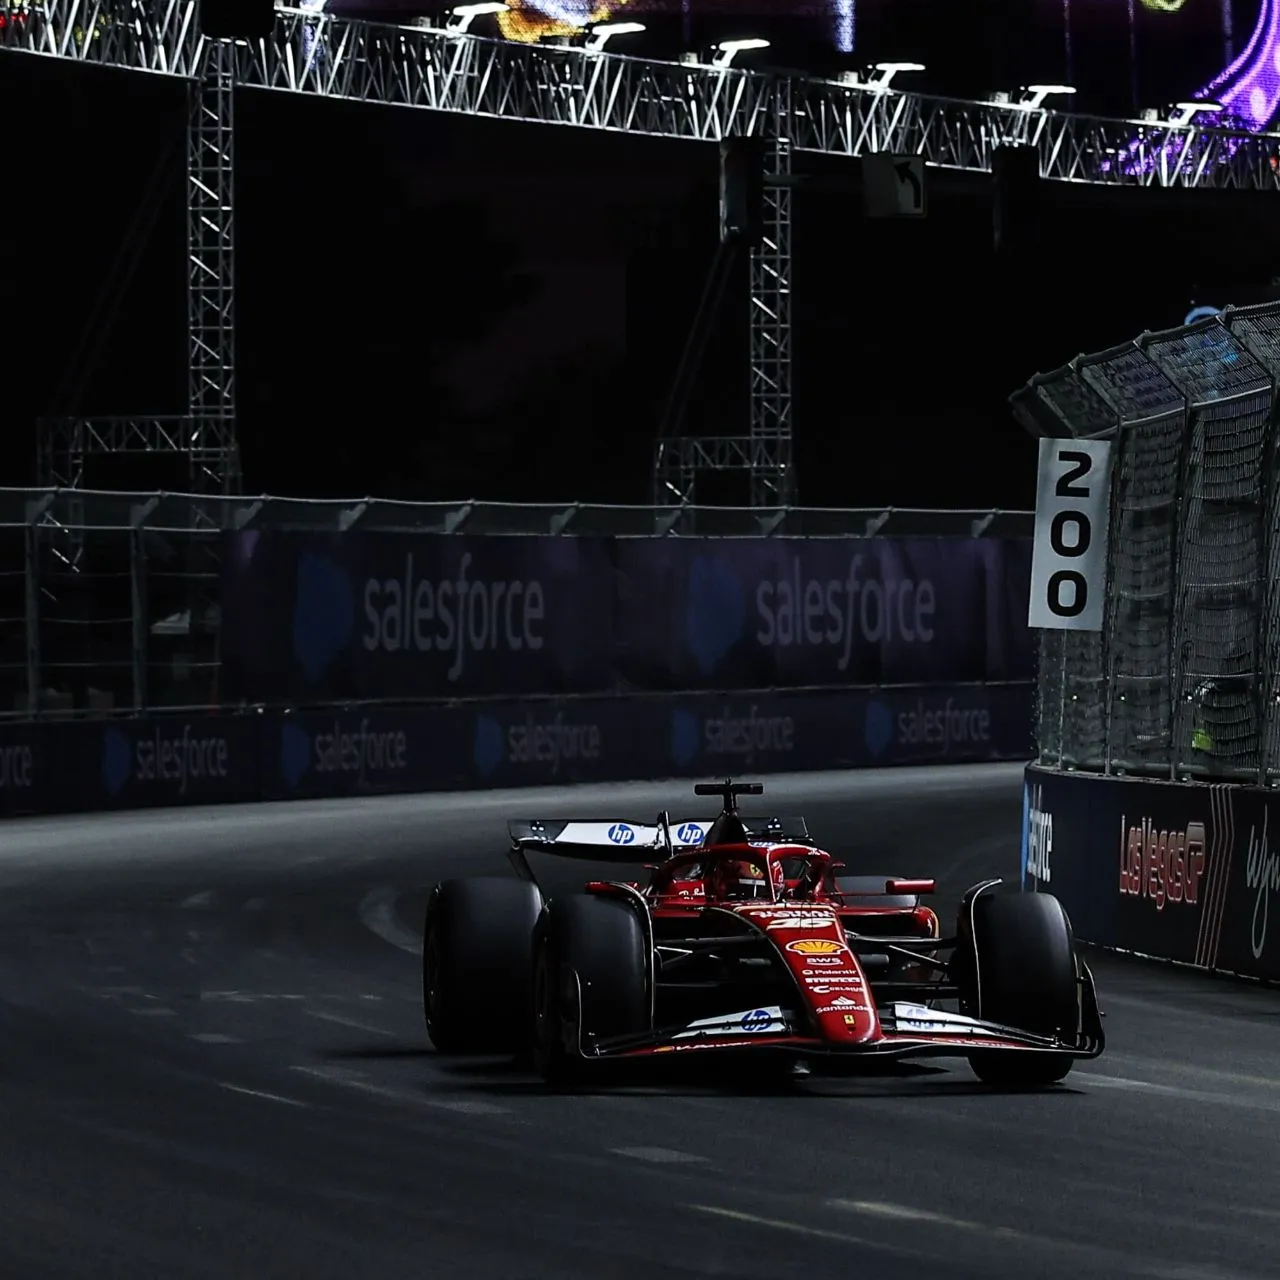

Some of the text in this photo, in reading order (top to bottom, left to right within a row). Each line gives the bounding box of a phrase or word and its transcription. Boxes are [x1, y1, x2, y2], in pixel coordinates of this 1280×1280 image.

[1047, 451, 1092, 616] 200
[363, 552, 545, 682] salesforce
[757, 553, 936, 672] salesforce
[314, 717, 407, 788] salesforce
[508, 710, 602, 775] salesforce
[898, 697, 991, 755] salesforce
[136, 725, 228, 795] salesforce
[610, 824, 632, 843] hp
[681, 824, 703, 844] hp
[744, 1011, 770, 1031] hp
[816, 1005, 872, 1014] Santande
